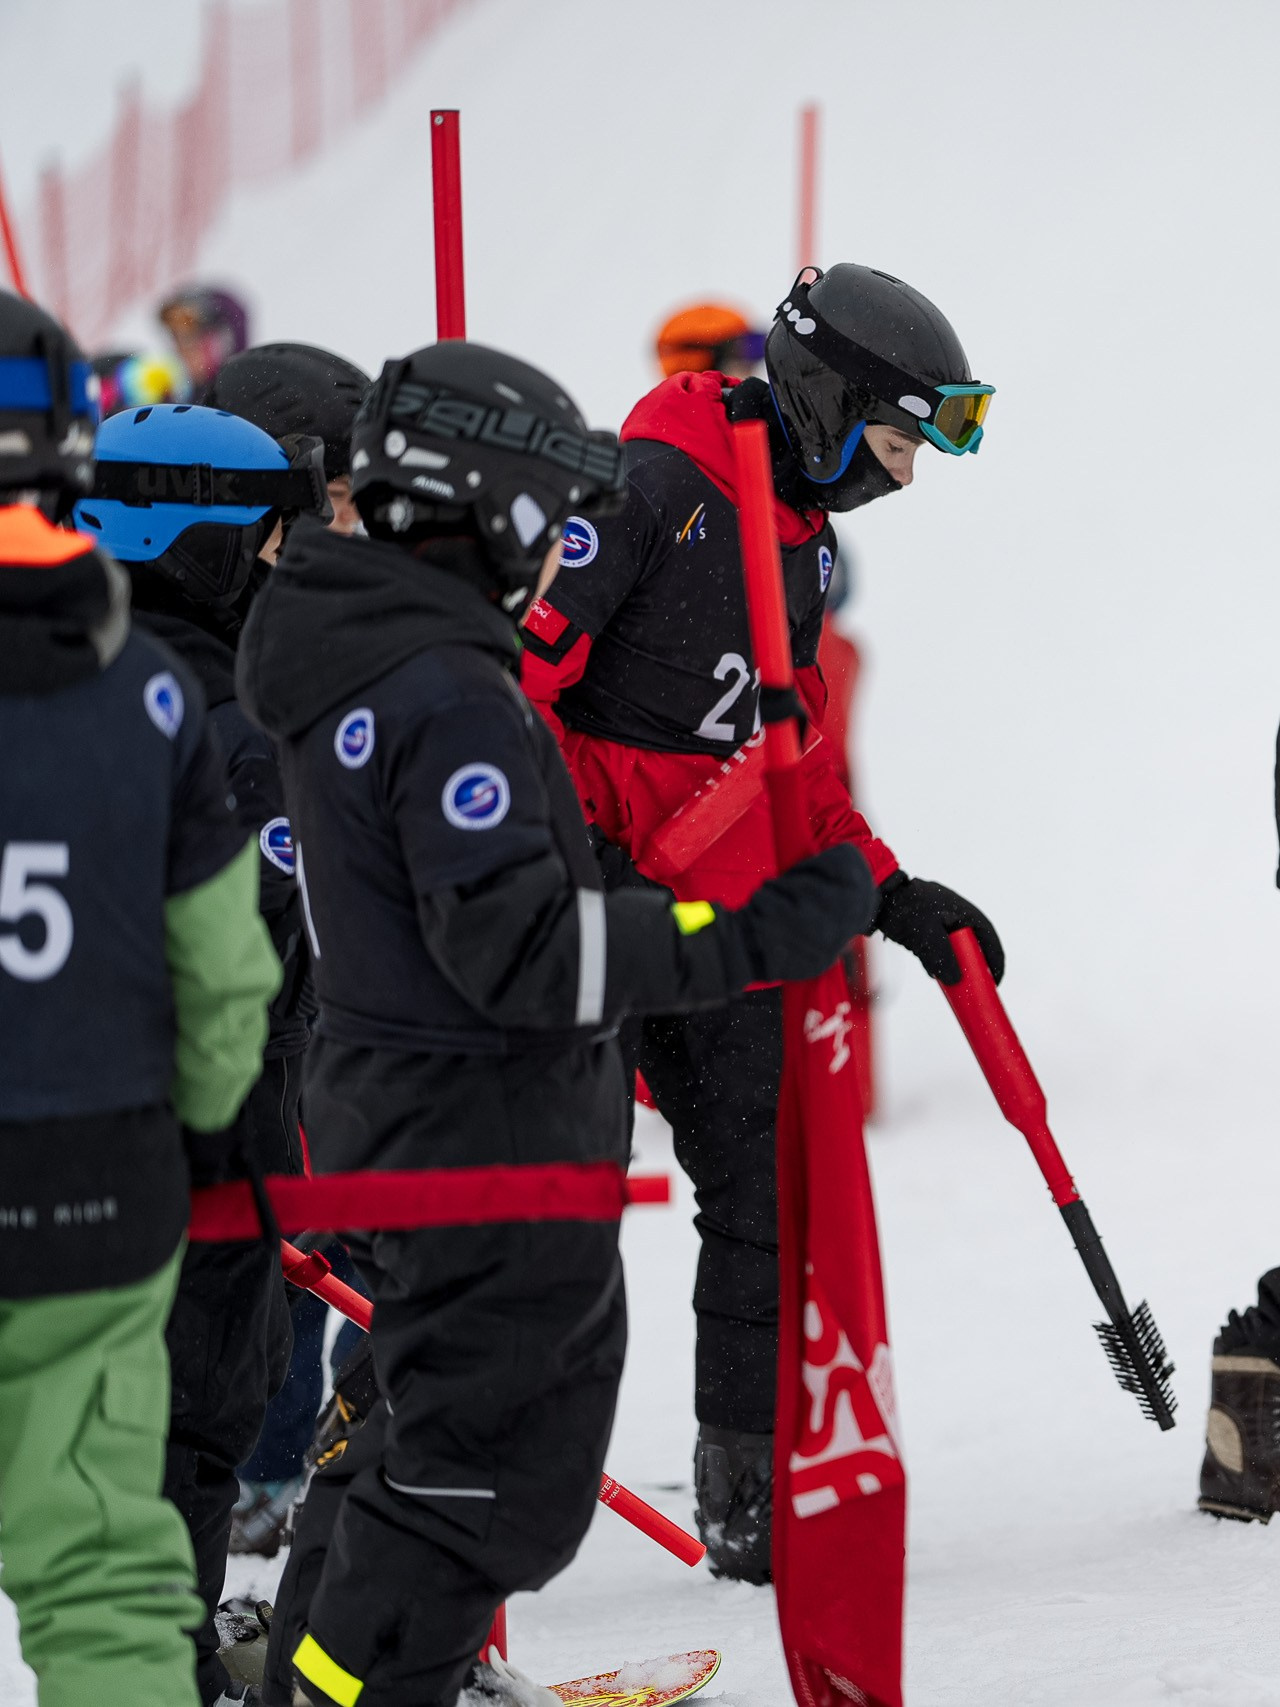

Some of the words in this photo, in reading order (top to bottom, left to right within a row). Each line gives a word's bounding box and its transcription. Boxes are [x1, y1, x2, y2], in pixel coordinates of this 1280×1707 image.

[137, 466, 240, 500] uvx
[676, 527, 706, 543] FIS
[693, 653, 761, 741] 2
[0, 841, 73, 982] 5
